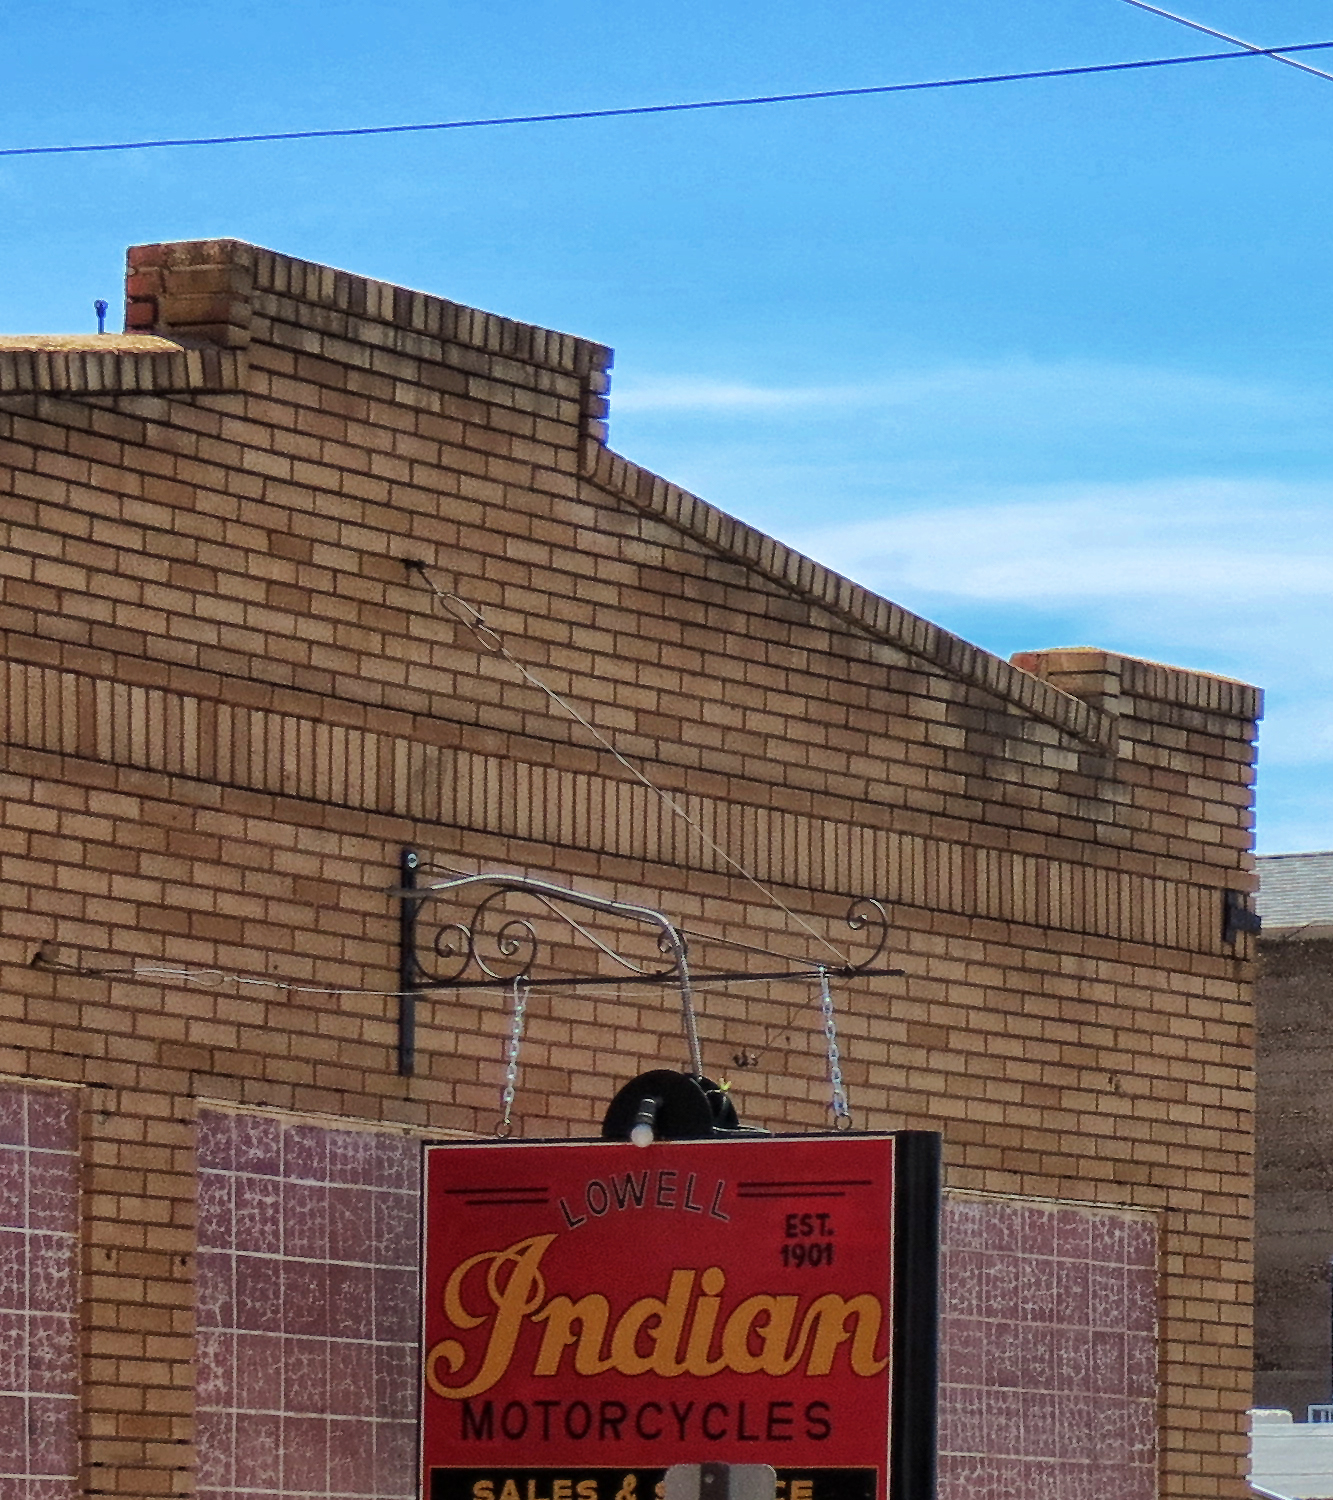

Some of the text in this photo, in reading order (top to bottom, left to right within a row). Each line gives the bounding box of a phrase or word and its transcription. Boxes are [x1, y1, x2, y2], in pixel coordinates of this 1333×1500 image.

[560, 1170, 731, 1230] LOWELL
[785, 1212, 834, 1239] EST.
[780, 1242, 834, 1268] 1901
[424, 1233, 889, 1401] Indian
[461, 1400, 832, 1443] MOTORCYCLES
